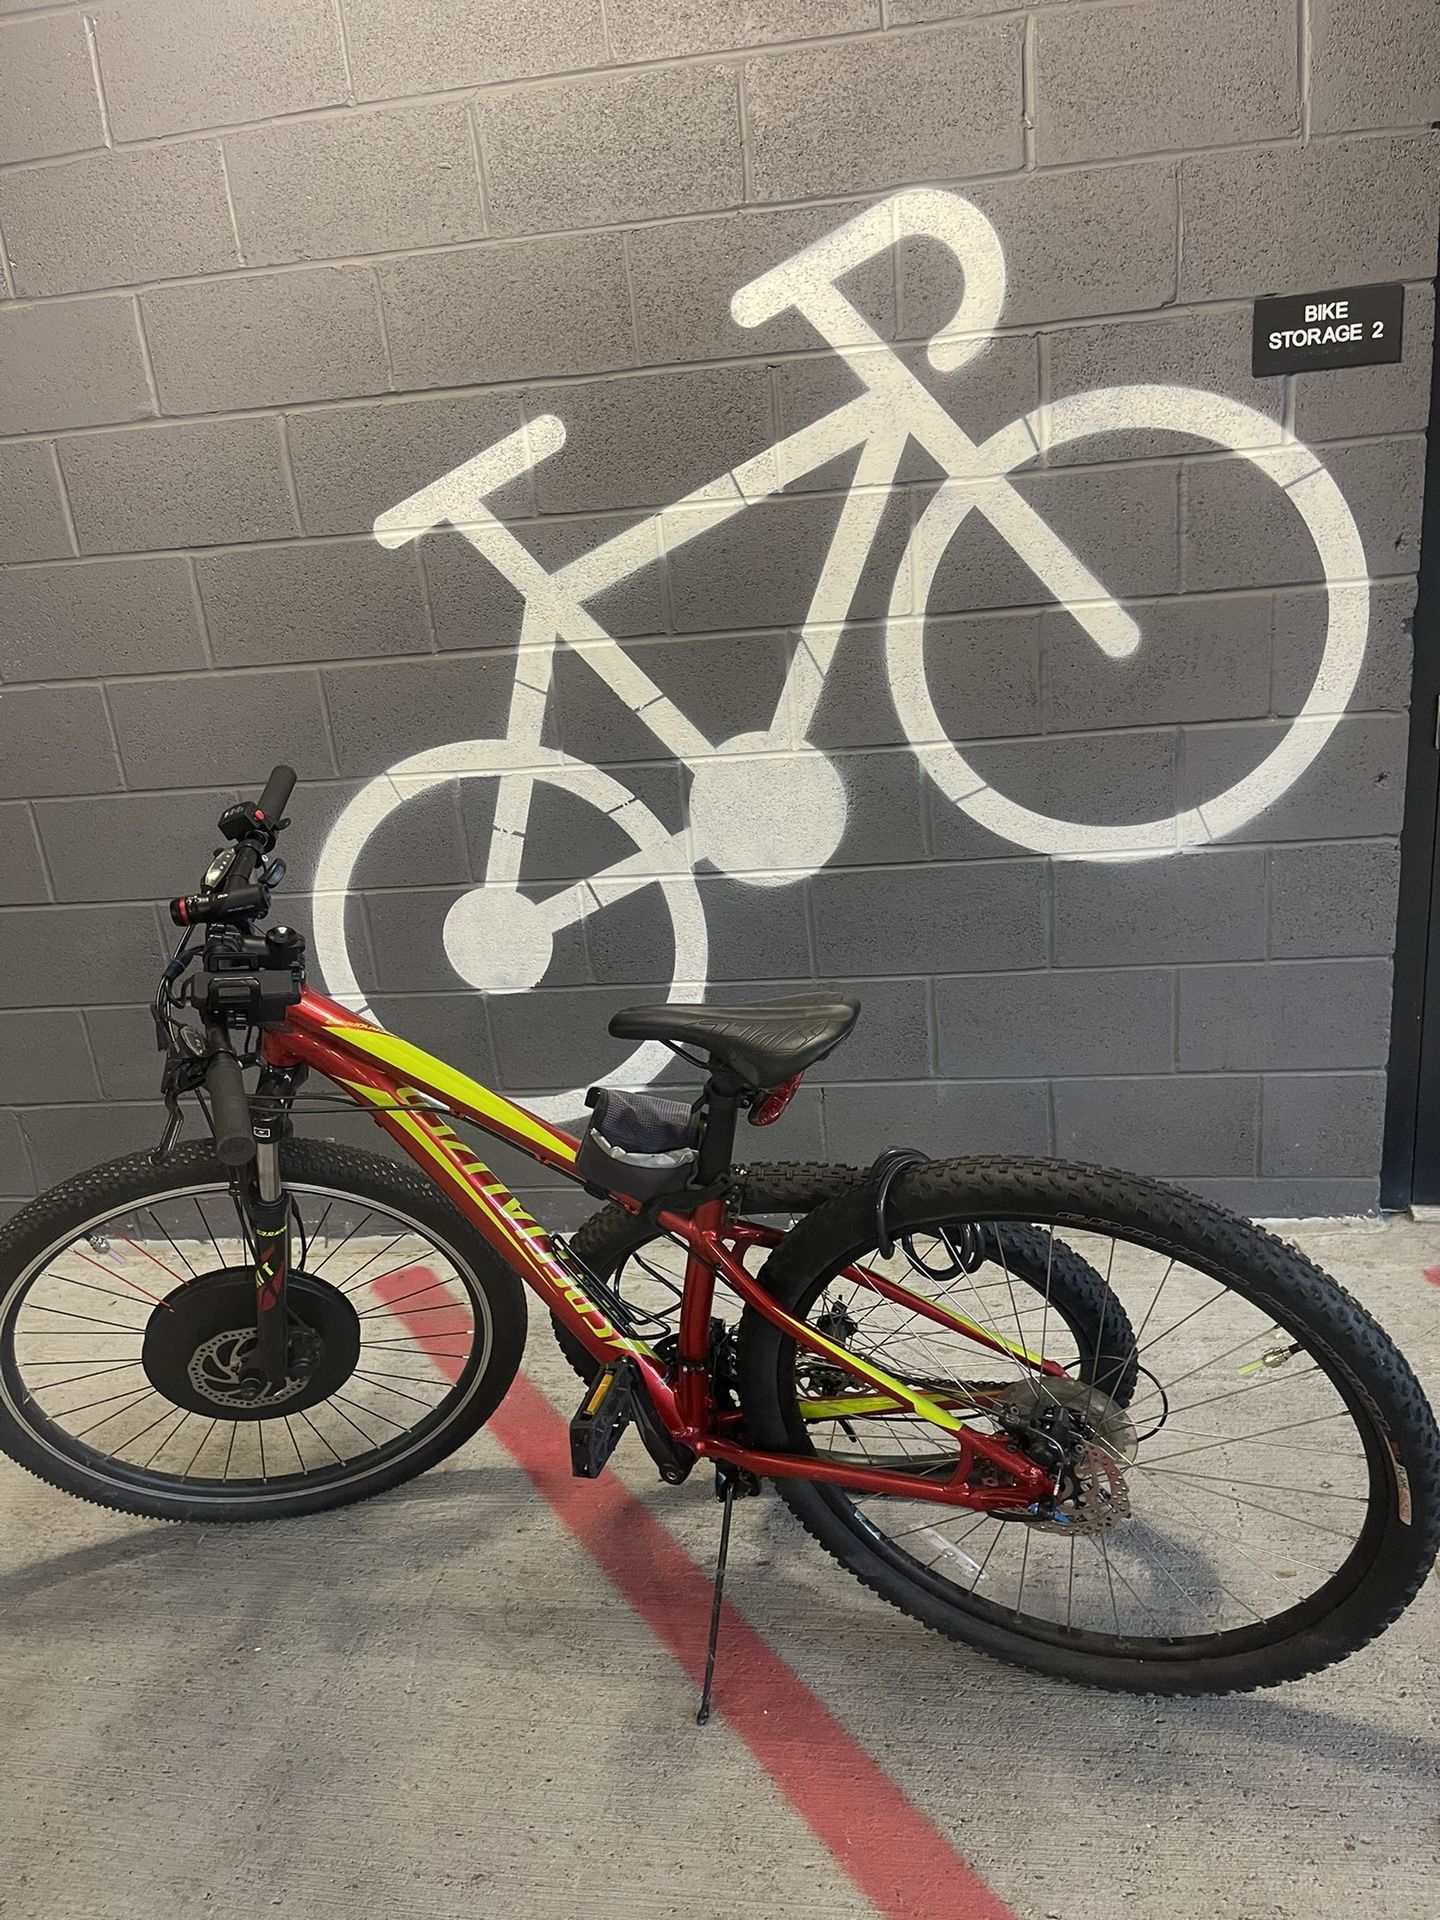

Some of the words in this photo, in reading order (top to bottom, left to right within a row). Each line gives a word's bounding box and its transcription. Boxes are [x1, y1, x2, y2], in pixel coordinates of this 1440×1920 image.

[1305, 301, 1349, 322] BIKE
[1268, 323, 1363, 349] STORAGE
[1371, 321, 1384, 338] 2
